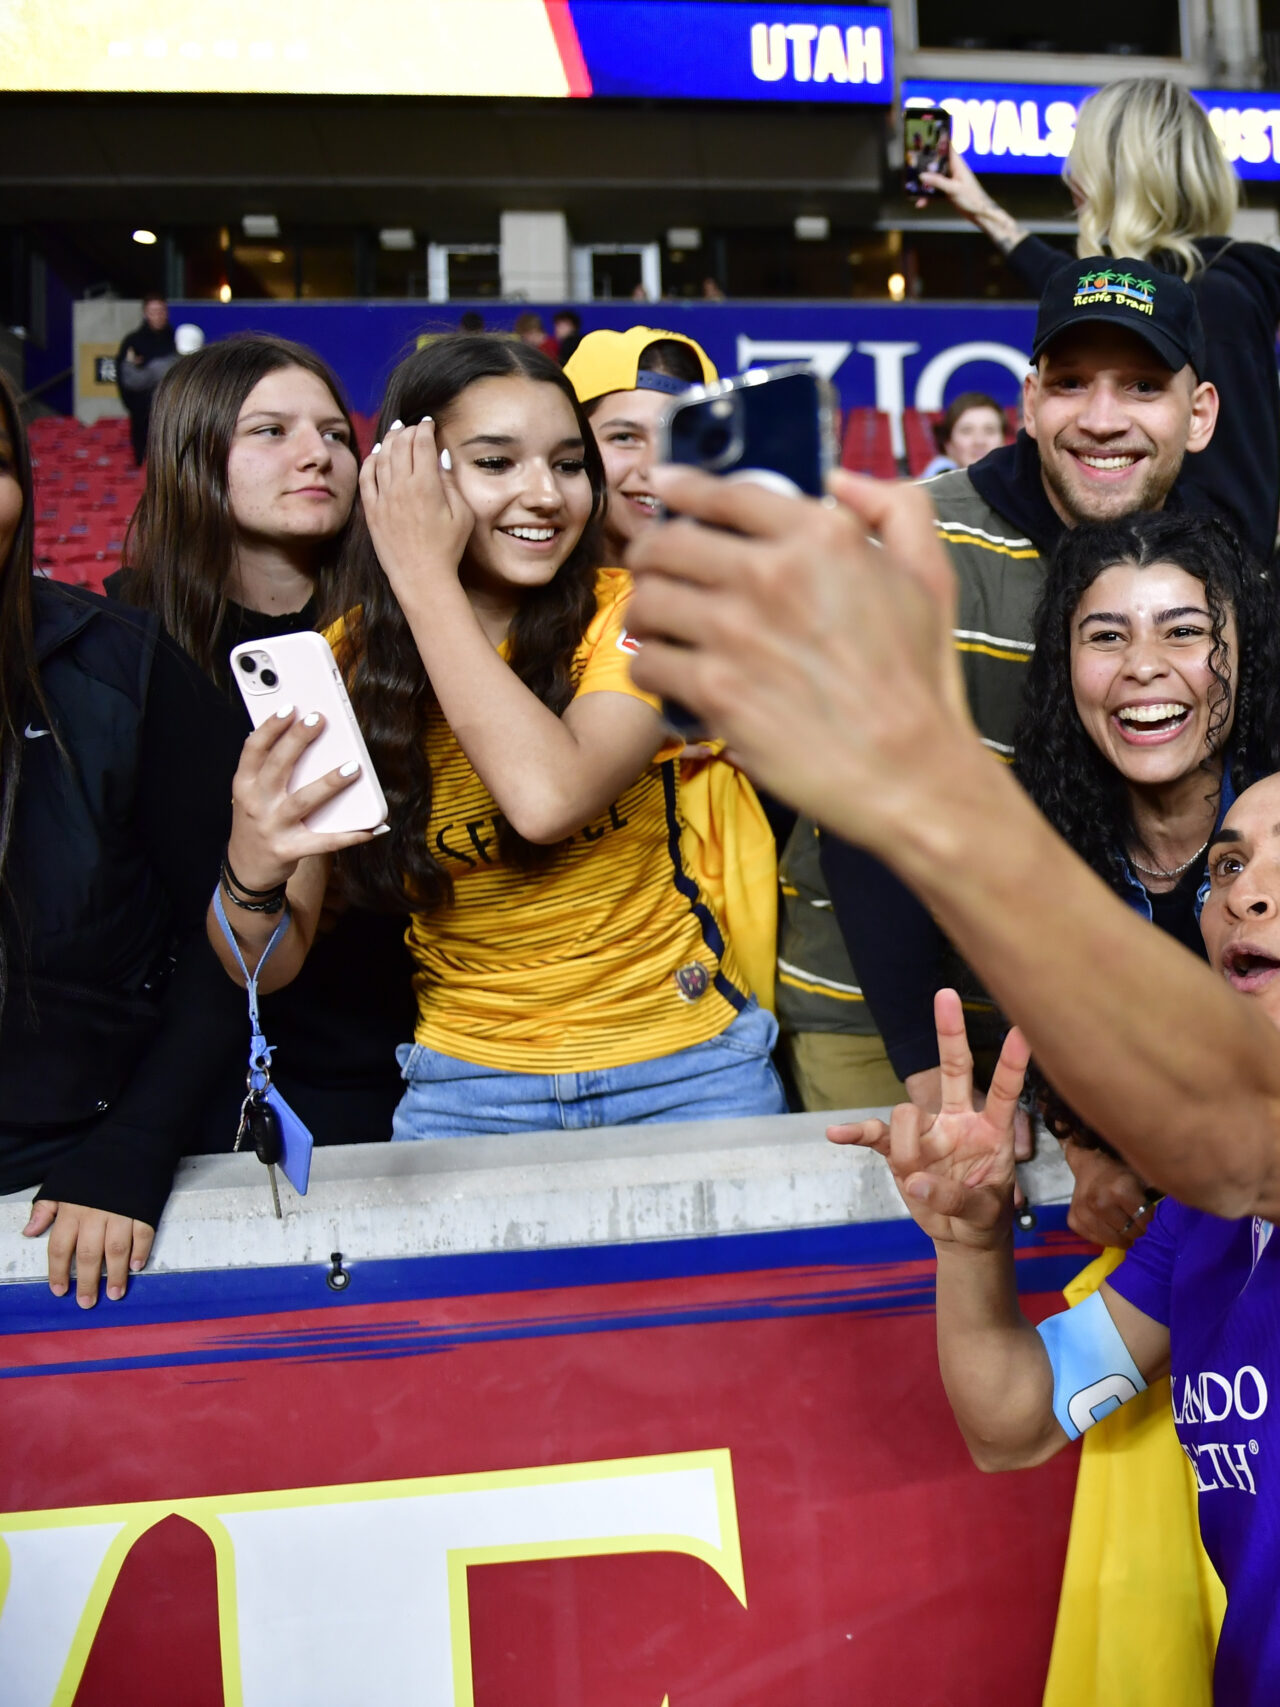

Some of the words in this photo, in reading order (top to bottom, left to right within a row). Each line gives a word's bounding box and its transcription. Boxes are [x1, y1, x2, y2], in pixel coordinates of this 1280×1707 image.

[750, 22, 884, 84] UTAH
[905, 97, 1077, 158] OYALS
[1115, 294, 1154, 316] Brasil
[1170, 1365, 1269, 1425] LANDO
